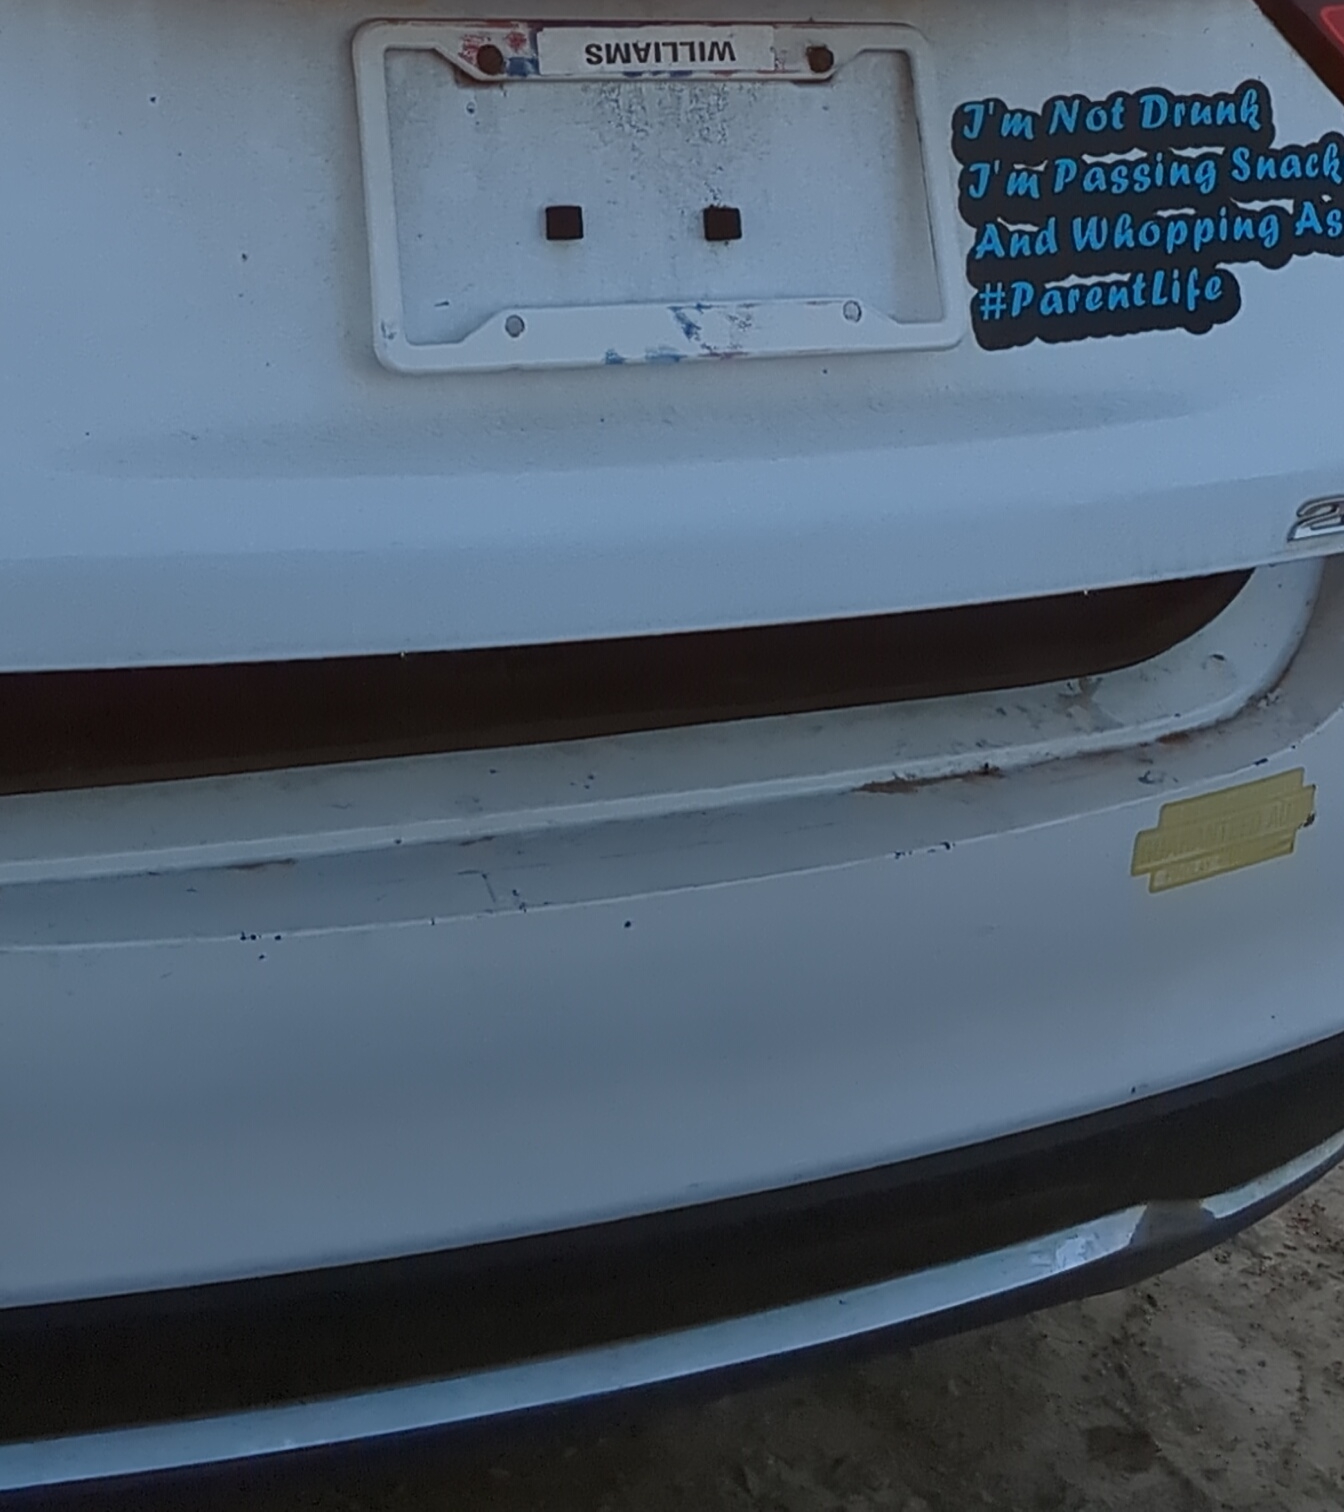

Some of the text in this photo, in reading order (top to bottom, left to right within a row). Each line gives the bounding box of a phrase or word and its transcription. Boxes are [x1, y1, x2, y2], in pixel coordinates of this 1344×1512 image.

[585, 39, 737, 66] WILLIAMS
[962, 88, 1262, 141] I'm Not Drunk
[968, 160, 1040, 199] I'm
[1053, 152, 1217, 194] Passing
[974, 216, 1058, 260] And
[1071, 206, 1280, 255] Whopping
[978, 266, 1224, 321] #ParentLife
